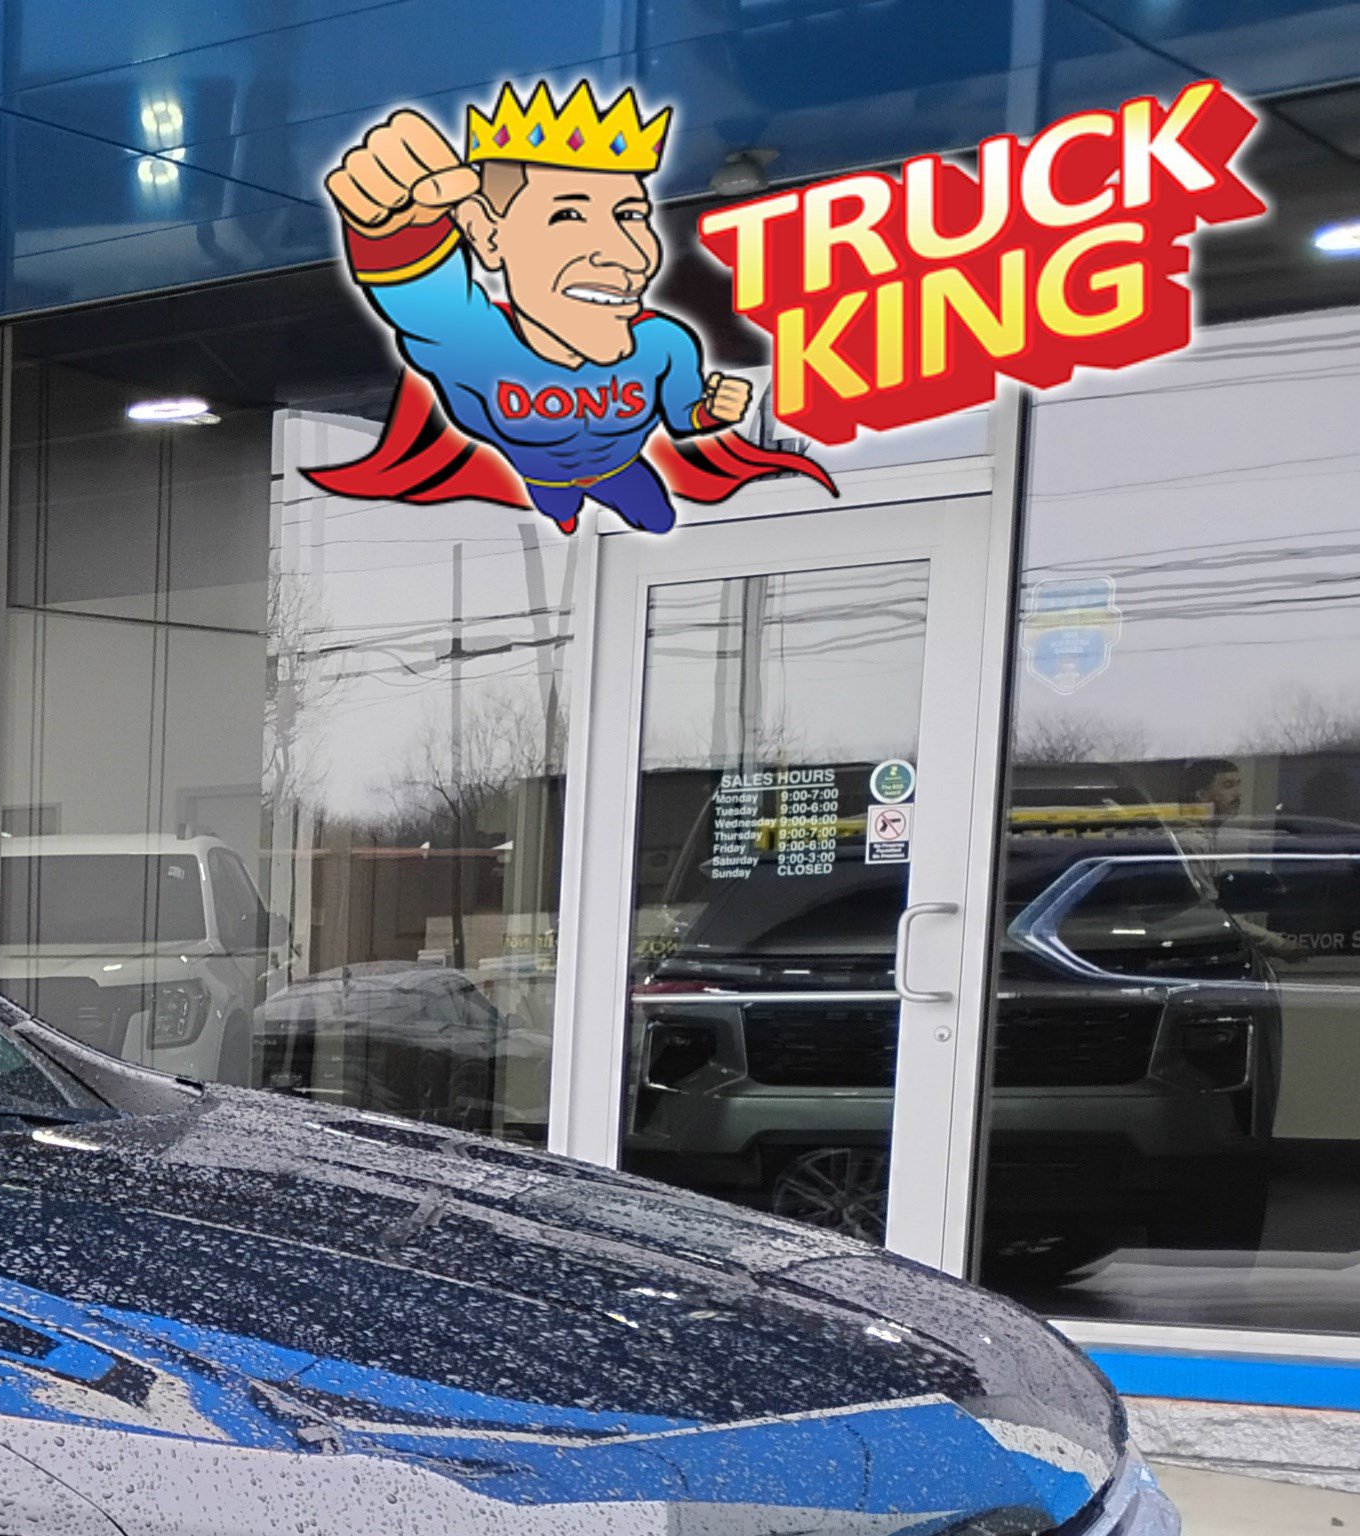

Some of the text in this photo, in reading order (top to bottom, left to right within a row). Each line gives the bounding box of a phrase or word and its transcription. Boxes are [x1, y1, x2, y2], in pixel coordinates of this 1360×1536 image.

[721, 769, 835, 788] SALES HOURS
[715, 788, 838, 804] Monday 9:00-7:00
[715, 801, 838, 817] Tuesday 9:00-6:00
[714, 814, 837, 829] Wednesday 9:00-6:00
[714, 827, 837, 841] Thursday 9:00-7:00
[713, 839, 836, 855] Friday 9:00-6:00
[712, 852, 836, 867] Saturday 9:00-3:00
[712, 863, 833, 879] Sunday CLOSED
